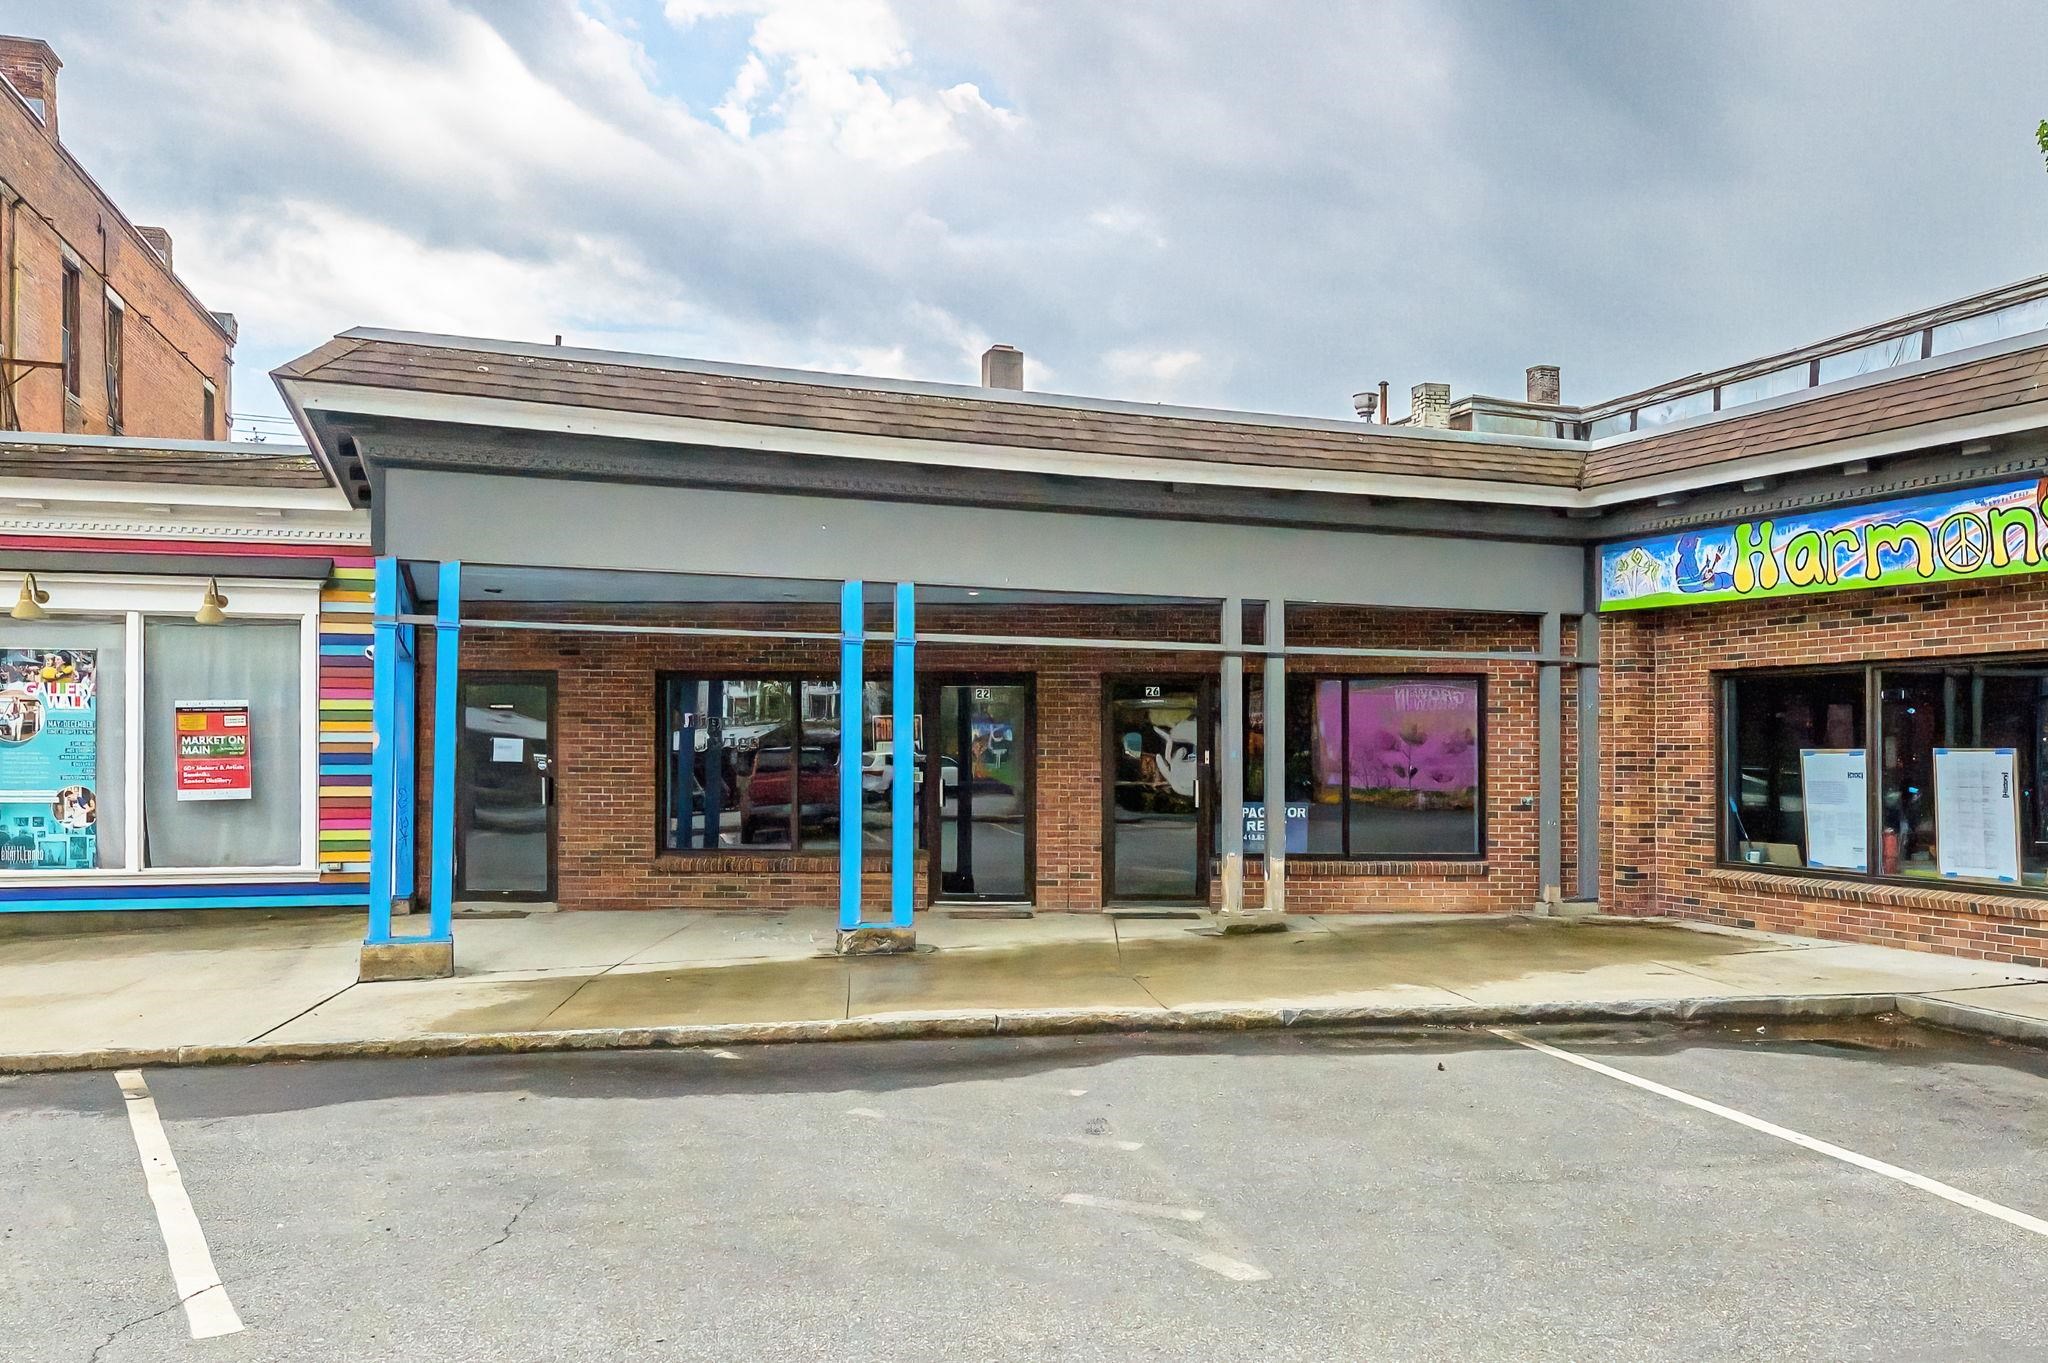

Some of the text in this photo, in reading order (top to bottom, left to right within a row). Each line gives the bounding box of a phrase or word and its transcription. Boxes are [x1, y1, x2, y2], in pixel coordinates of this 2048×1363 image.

[977, 690, 990, 698] 22
[1147, 688, 1160, 696] 26
[182, 735, 245, 745] MARKET ON
[182, 746, 210, 755] MAIN
[1242, 808, 1306, 818] PAC OR
